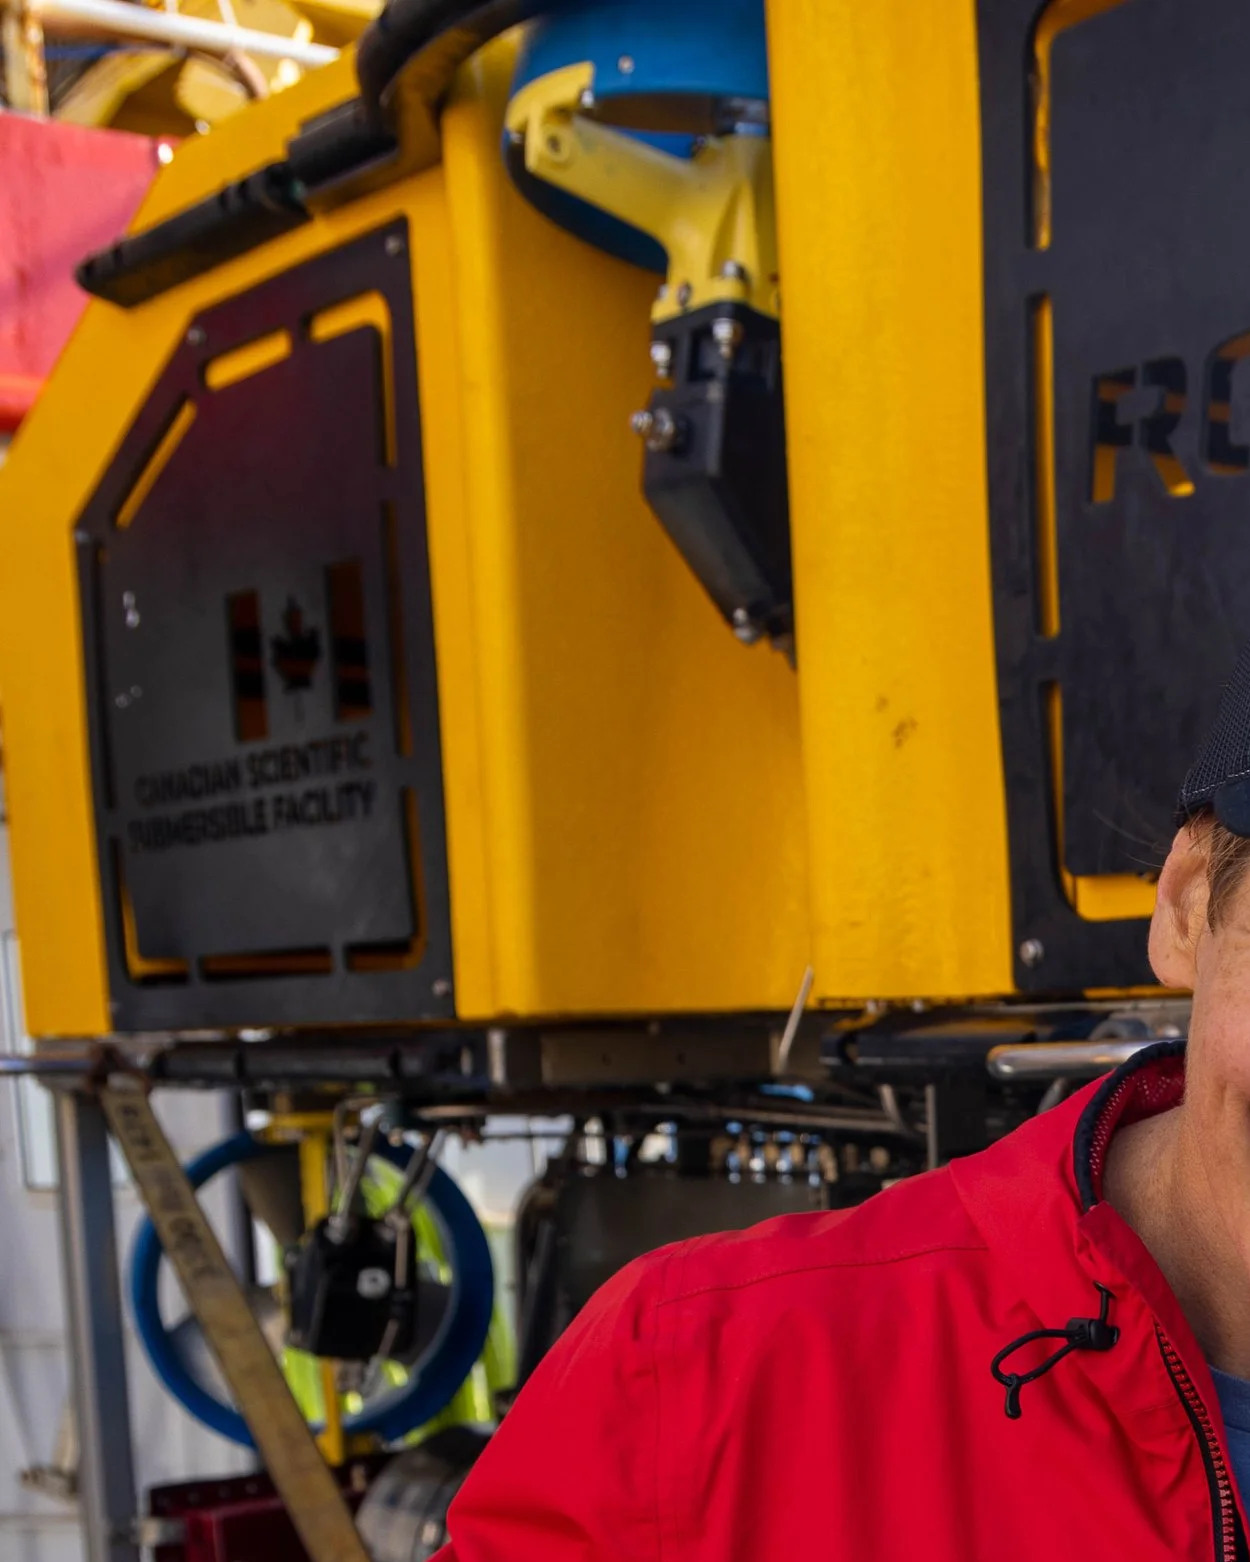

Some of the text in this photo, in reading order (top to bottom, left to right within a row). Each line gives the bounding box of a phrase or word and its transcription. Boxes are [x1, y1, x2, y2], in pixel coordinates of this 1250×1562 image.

[133, 730, 374, 808] CANADIAN SCIENTIFIC
[126, 779, 378, 854] SUBMERSIBLE FACILITY
